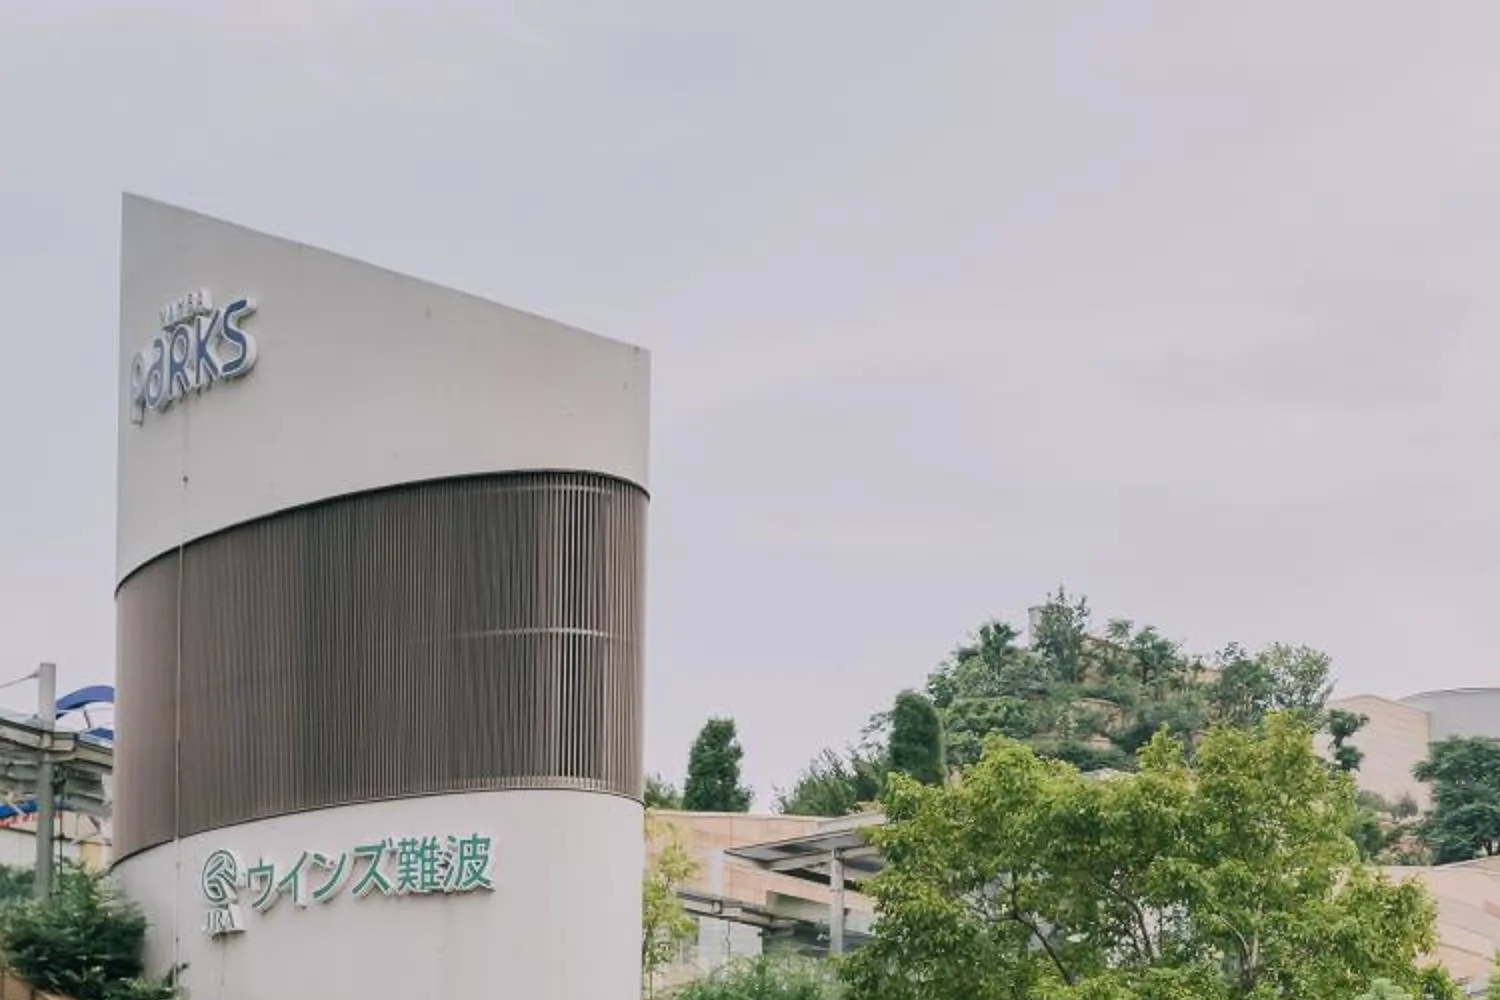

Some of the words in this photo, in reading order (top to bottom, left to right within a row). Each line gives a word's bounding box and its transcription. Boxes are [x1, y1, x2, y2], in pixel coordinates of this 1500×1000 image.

[247, 832, 495, 909] ウインズ難波
